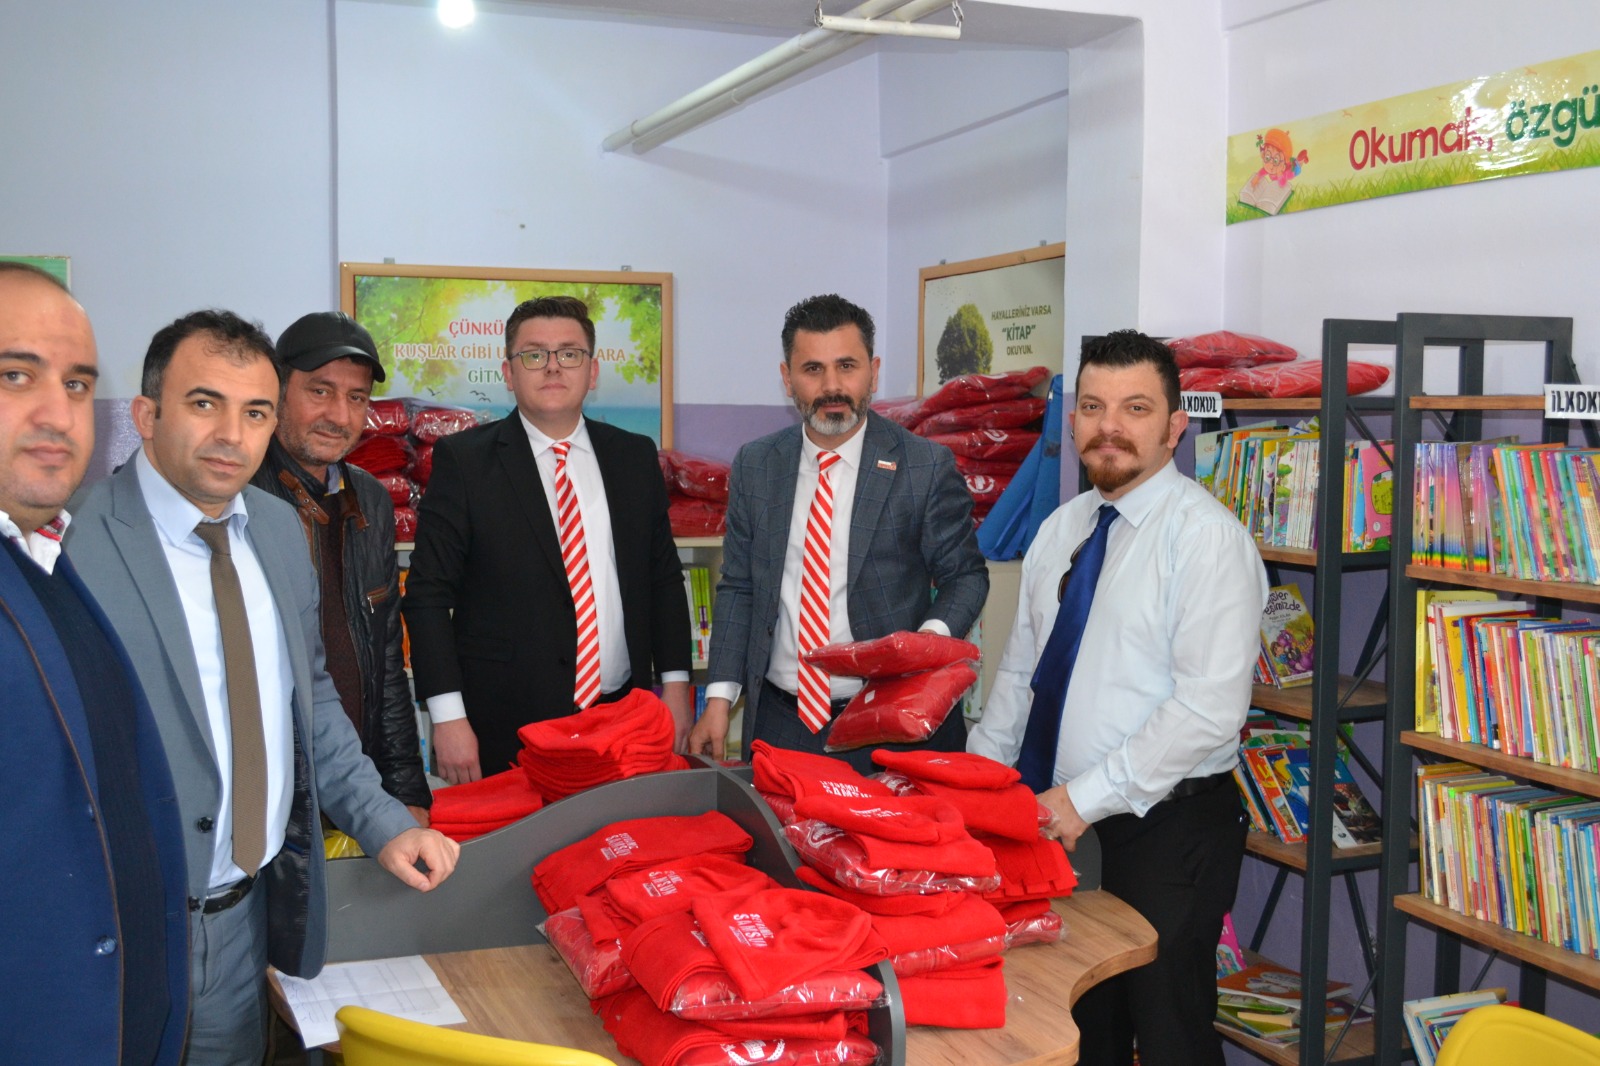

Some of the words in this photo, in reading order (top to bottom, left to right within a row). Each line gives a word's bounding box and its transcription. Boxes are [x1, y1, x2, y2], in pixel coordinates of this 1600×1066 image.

[992, 304, 1031, 320] HAYALLERİNİZ
[1032, 305, 1052, 316] VARSA
[448, 318, 504, 338] ÇÜNKÜ
[394, 343, 457, 362] KUŞLAR
[460, 342, 492, 360] GİBİ
[596, 347, 626, 362] ARA
[1006, 344, 1033, 356] OKUYUN.
[467, 366, 508, 384] GİTM
[1263, 599, 1302, 615] eşimizde
